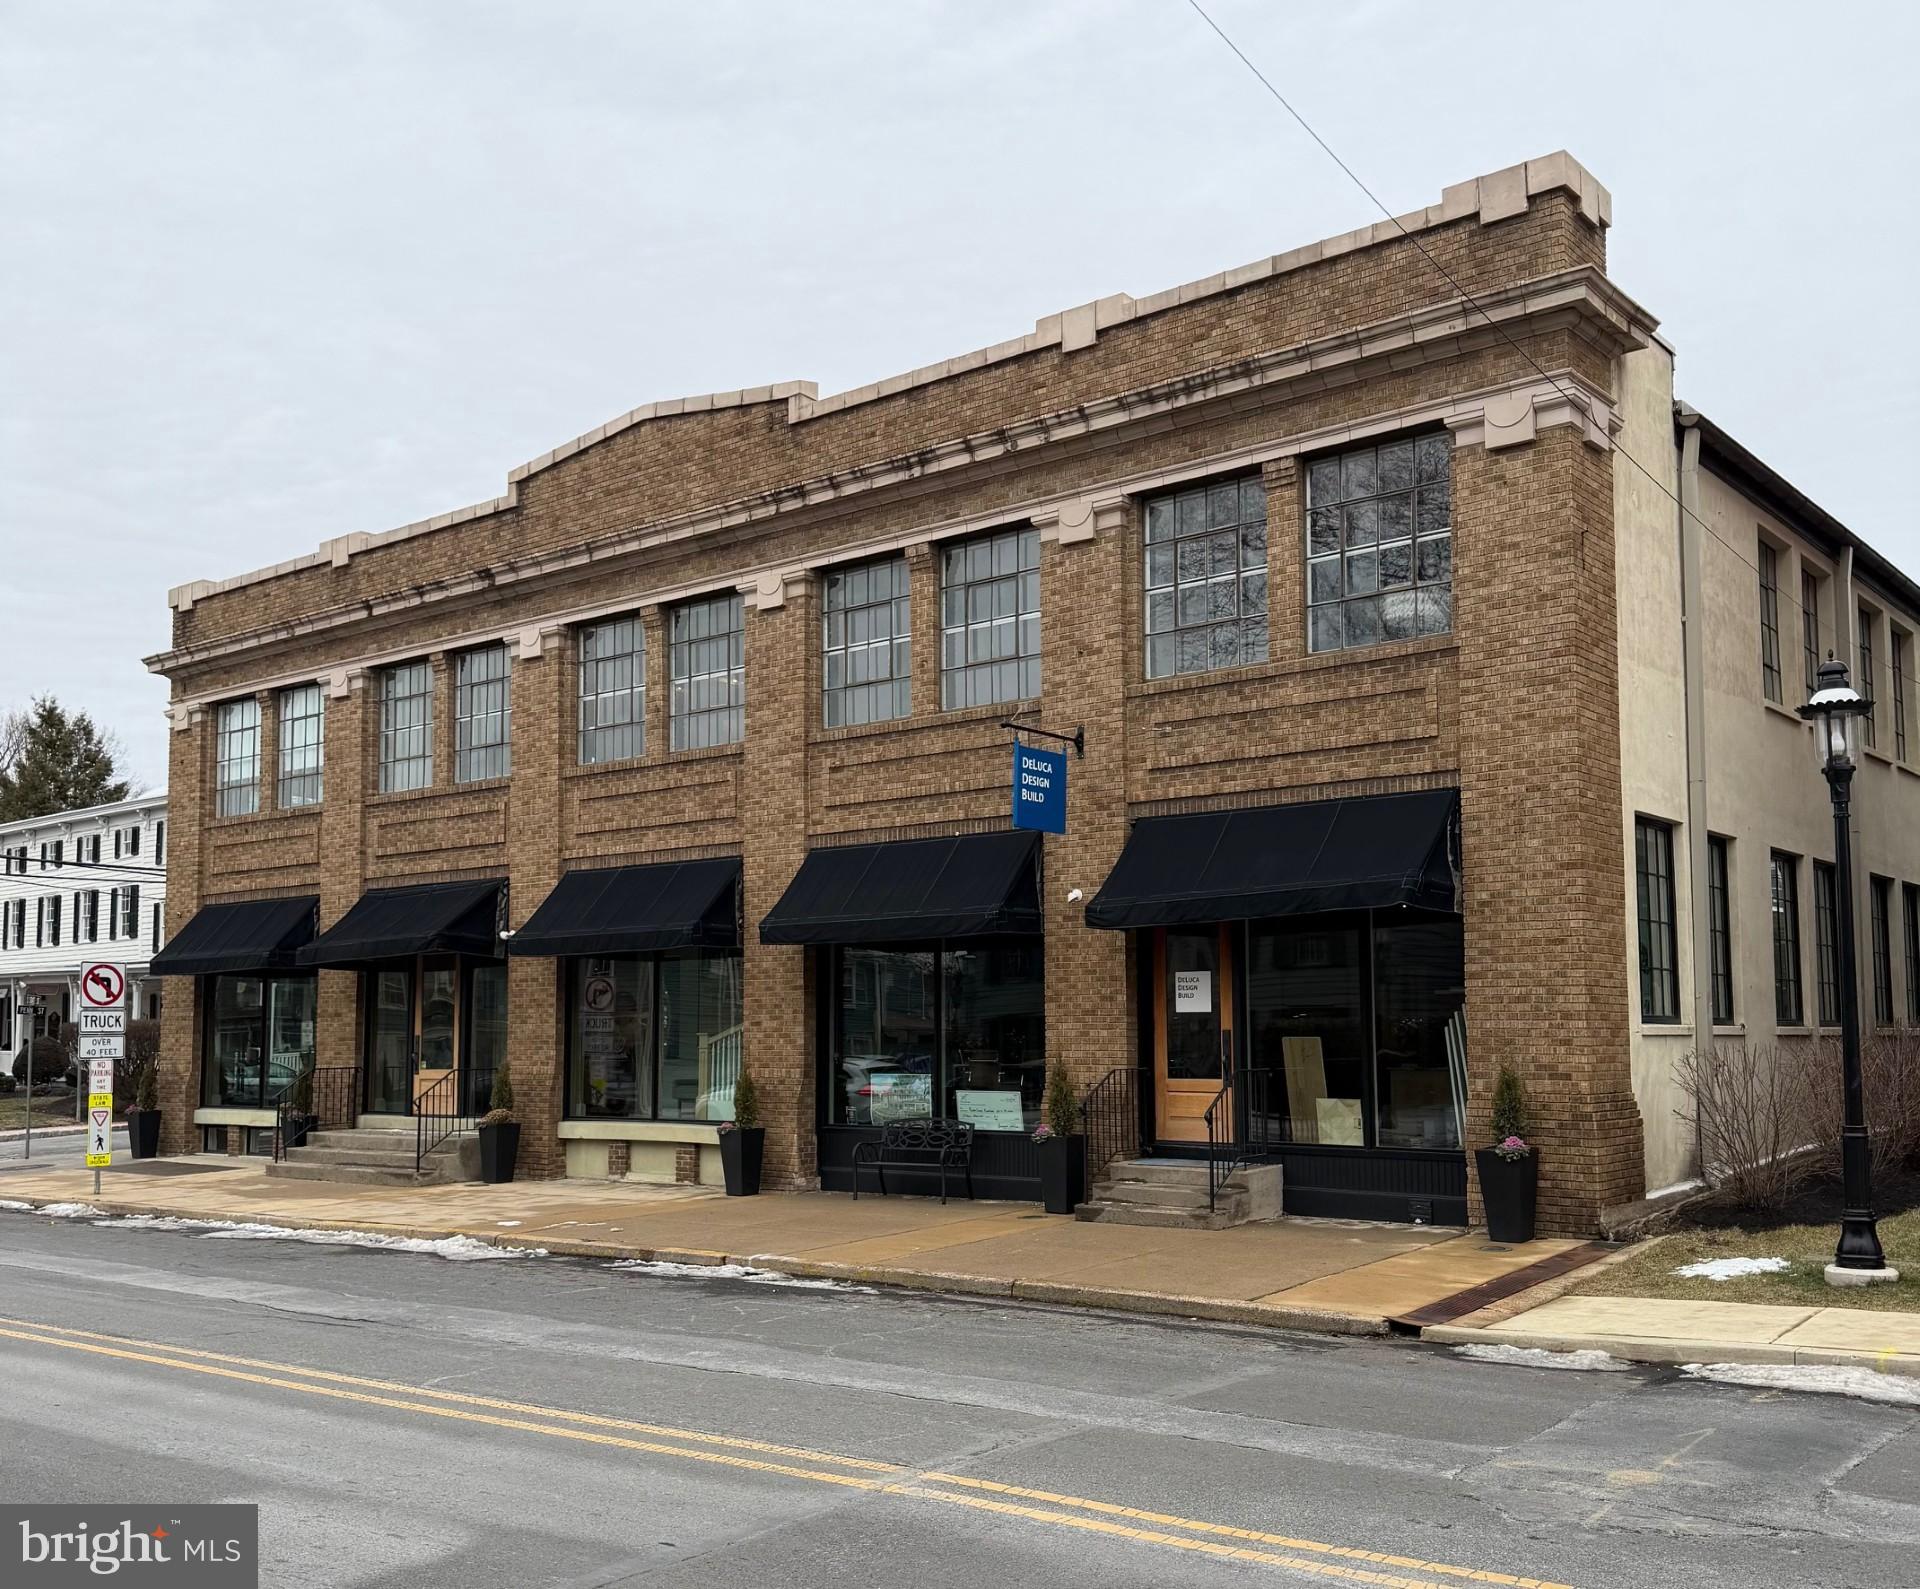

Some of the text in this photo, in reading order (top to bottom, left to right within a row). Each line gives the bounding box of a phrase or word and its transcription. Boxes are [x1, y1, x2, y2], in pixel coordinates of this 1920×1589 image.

[83, 1015, 122, 1028] TRUCK
[91, 1038, 111, 1046] OVER
[86, 1048, 118, 1056] 40 FEET
[96, 1061, 106, 1069] NO
[90, 1069, 112, 1077] PARKING
